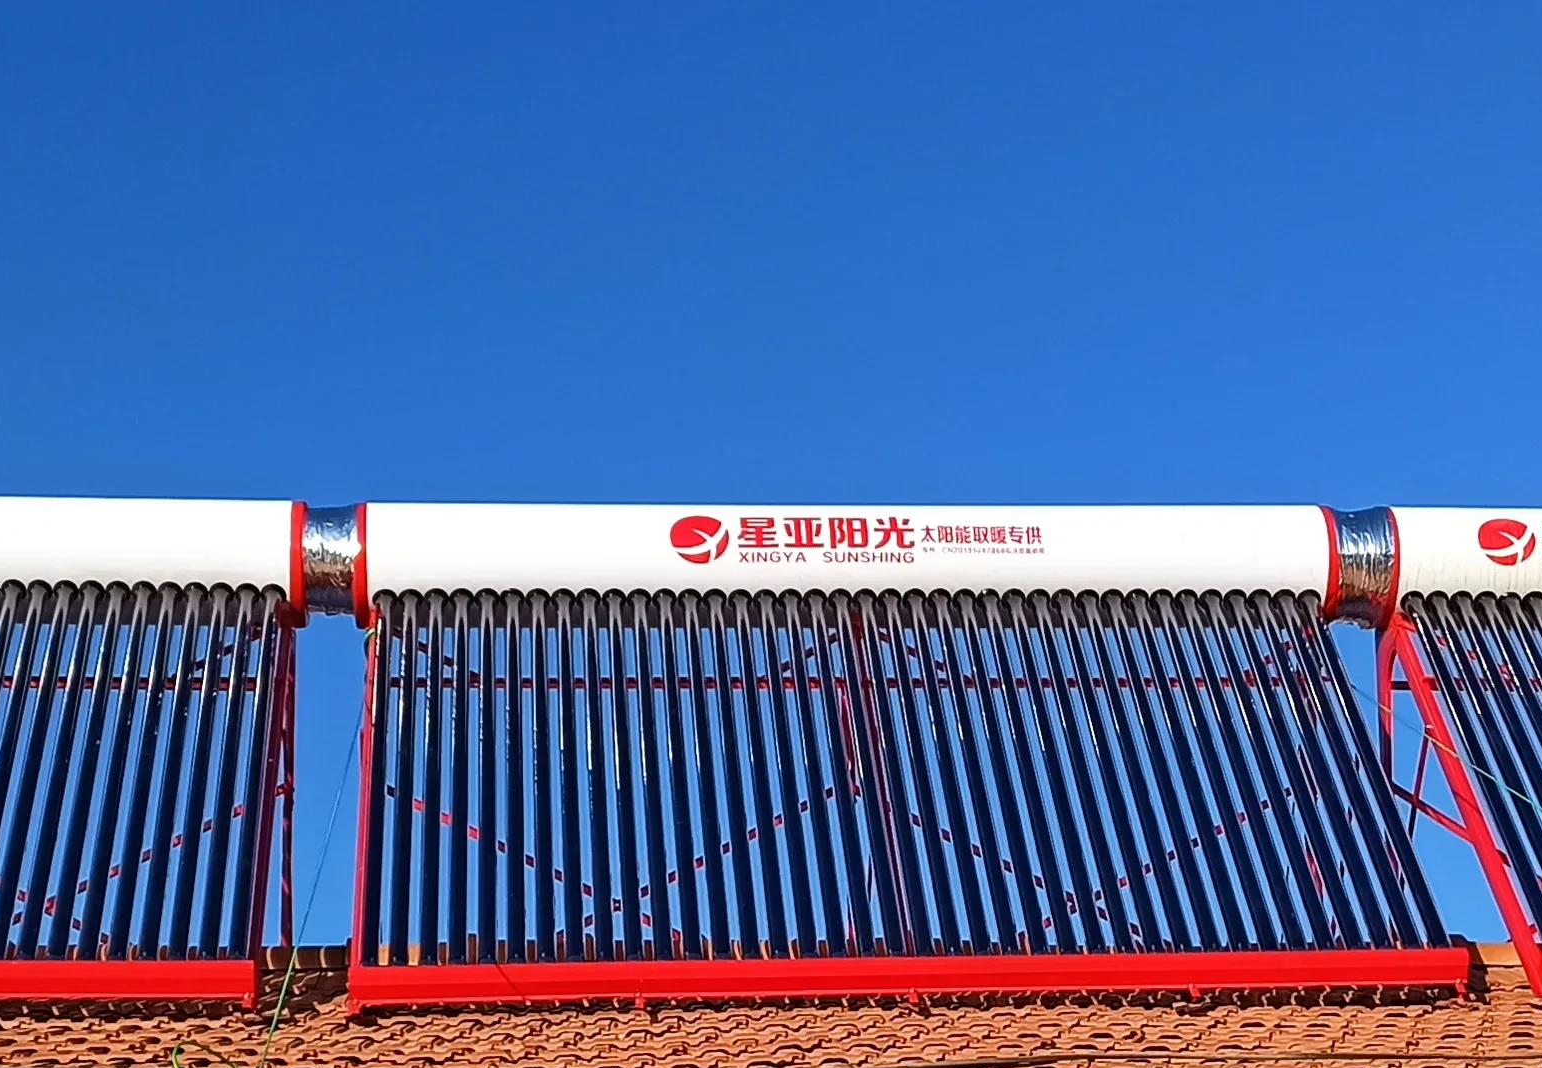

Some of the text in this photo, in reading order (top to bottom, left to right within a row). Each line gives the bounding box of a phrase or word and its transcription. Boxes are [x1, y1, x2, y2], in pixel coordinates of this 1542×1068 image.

[738, 516, 915, 549] 星亚阳光
[920, 525, 1043, 545] 太阳能取暖专供
[738, 552, 915, 565] XINGYA SUNSHING
